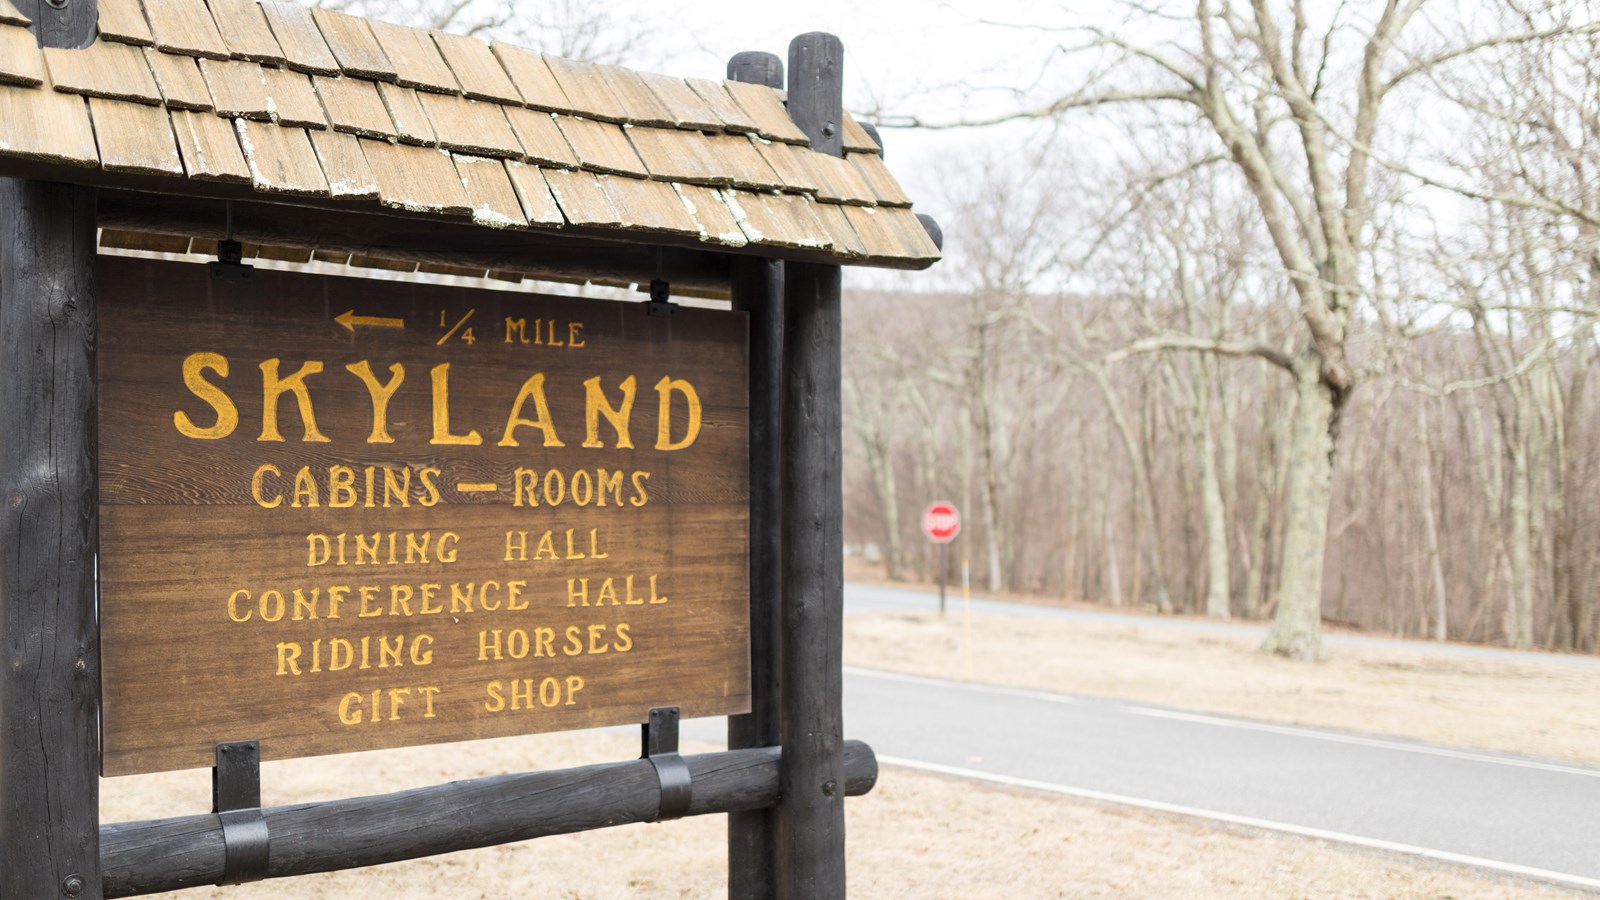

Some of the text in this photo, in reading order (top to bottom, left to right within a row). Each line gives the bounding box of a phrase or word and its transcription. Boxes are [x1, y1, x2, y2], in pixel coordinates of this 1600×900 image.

[504, 317, 586, 348] MILE
[173, 351, 703, 452] SKYLAND
[251, 463, 442, 510] CABINS
[512, 466, 651, 509] ROOMS
[927, 513, 957, 530] STOP
[306, 527, 609, 567] DINING HALL
[227, 574, 669, 623] CONFERENCE HALL
[276, 622, 634, 676] RIDING HORSES
[338, 675, 586, 726] GIFT SHOP
